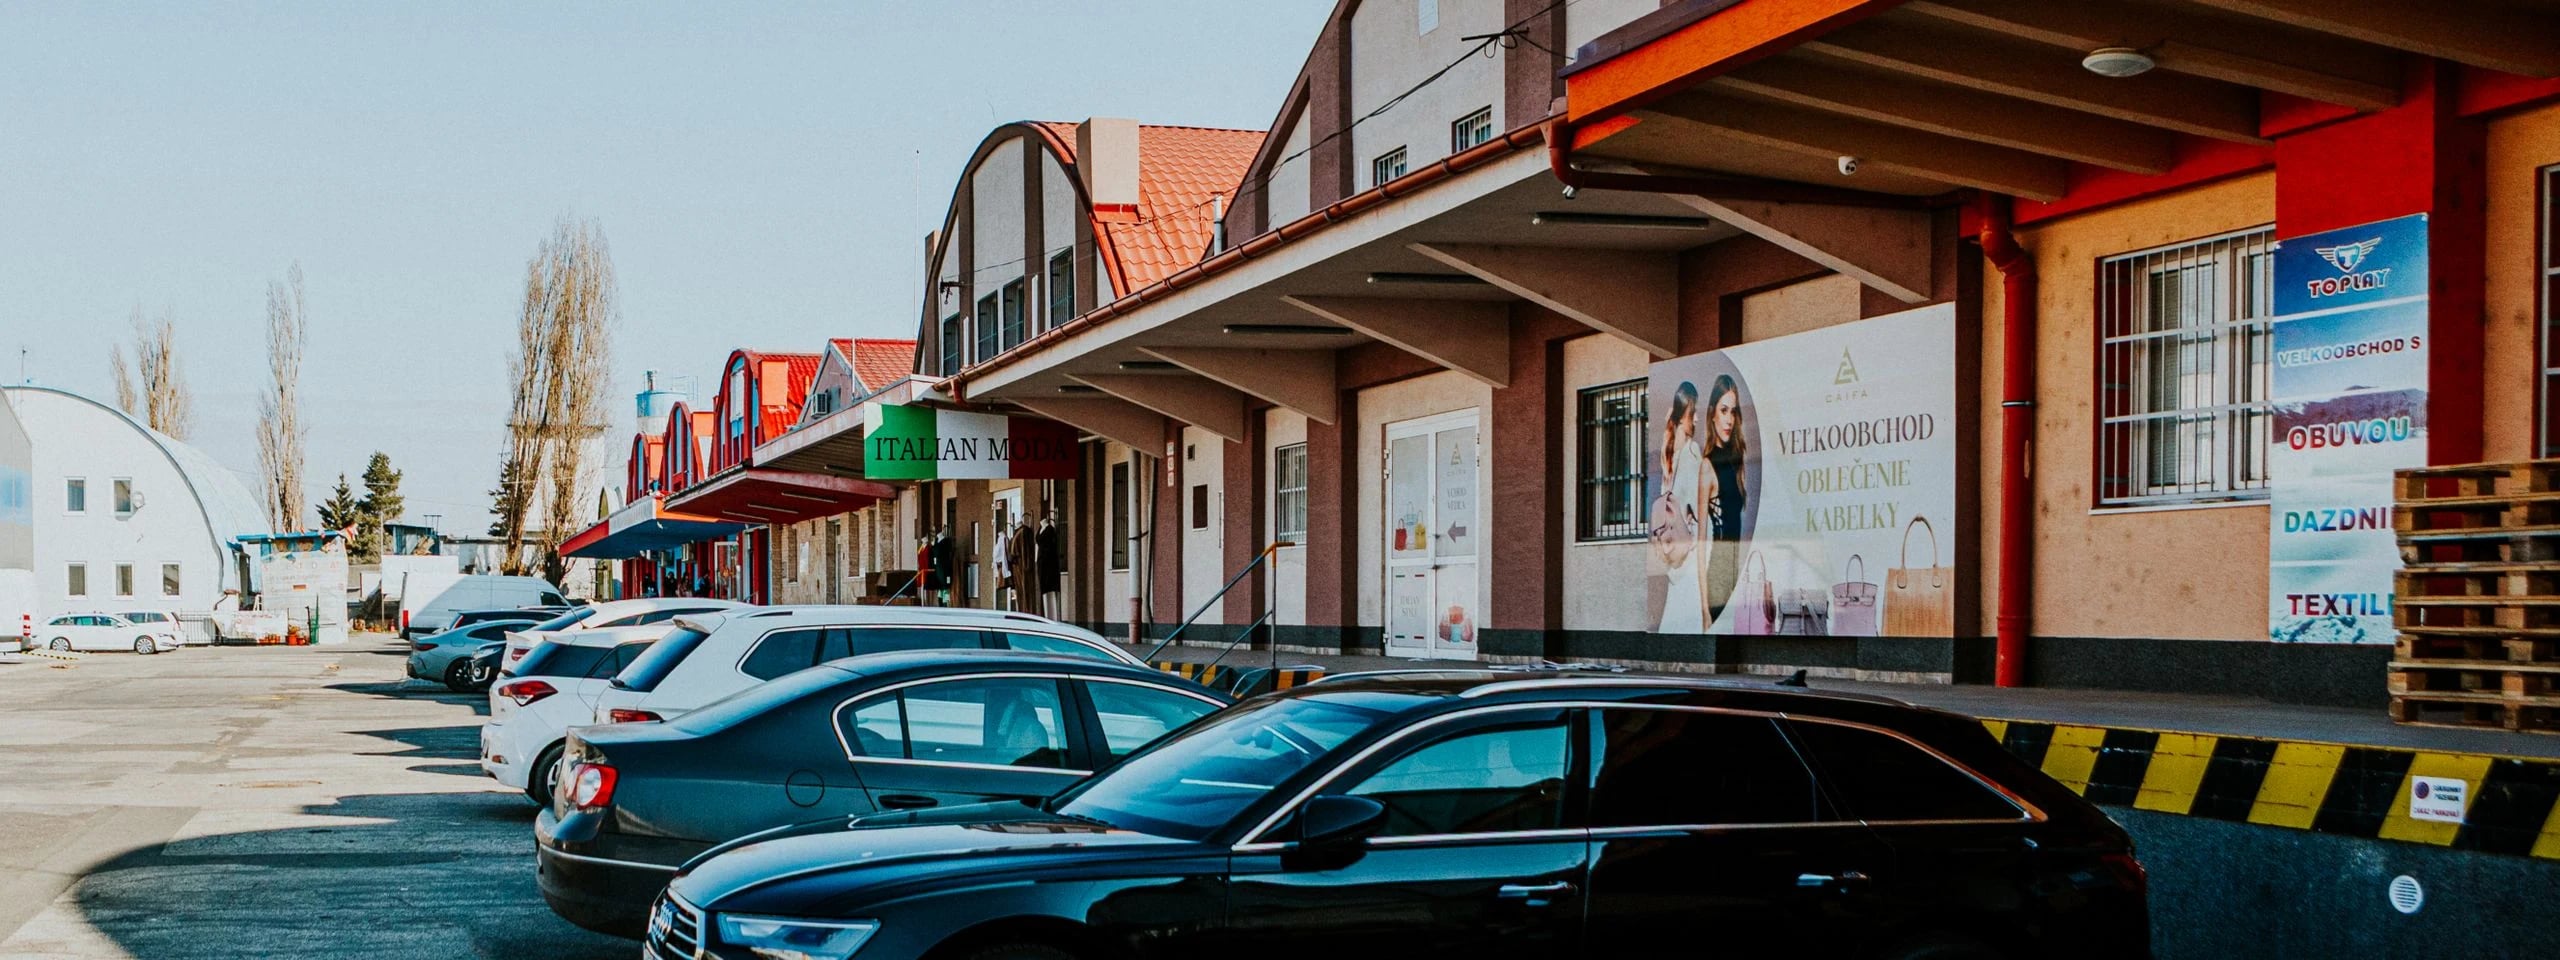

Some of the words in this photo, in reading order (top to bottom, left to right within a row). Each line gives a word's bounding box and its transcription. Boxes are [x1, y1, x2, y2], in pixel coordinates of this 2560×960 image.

[2308, 268, 2391, 298] TOPLAY
[2410, 335, 2421, 350] S
[1825, 389, 1868, 403] CAIFA
[1778, 413, 1934, 455] VEĽKOOBCHOD
[2287, 416, 2409, 451] OBUVOU
[875, 437, 978, 461] ITALIAN
[988, 437, 1068, 461] MODA
[1797, 458, 1911, 494] OBLEČENIE
[1806, 501, 1899, 533] KABELKY
[2284, 506, 2397, 534] DAZDNI
